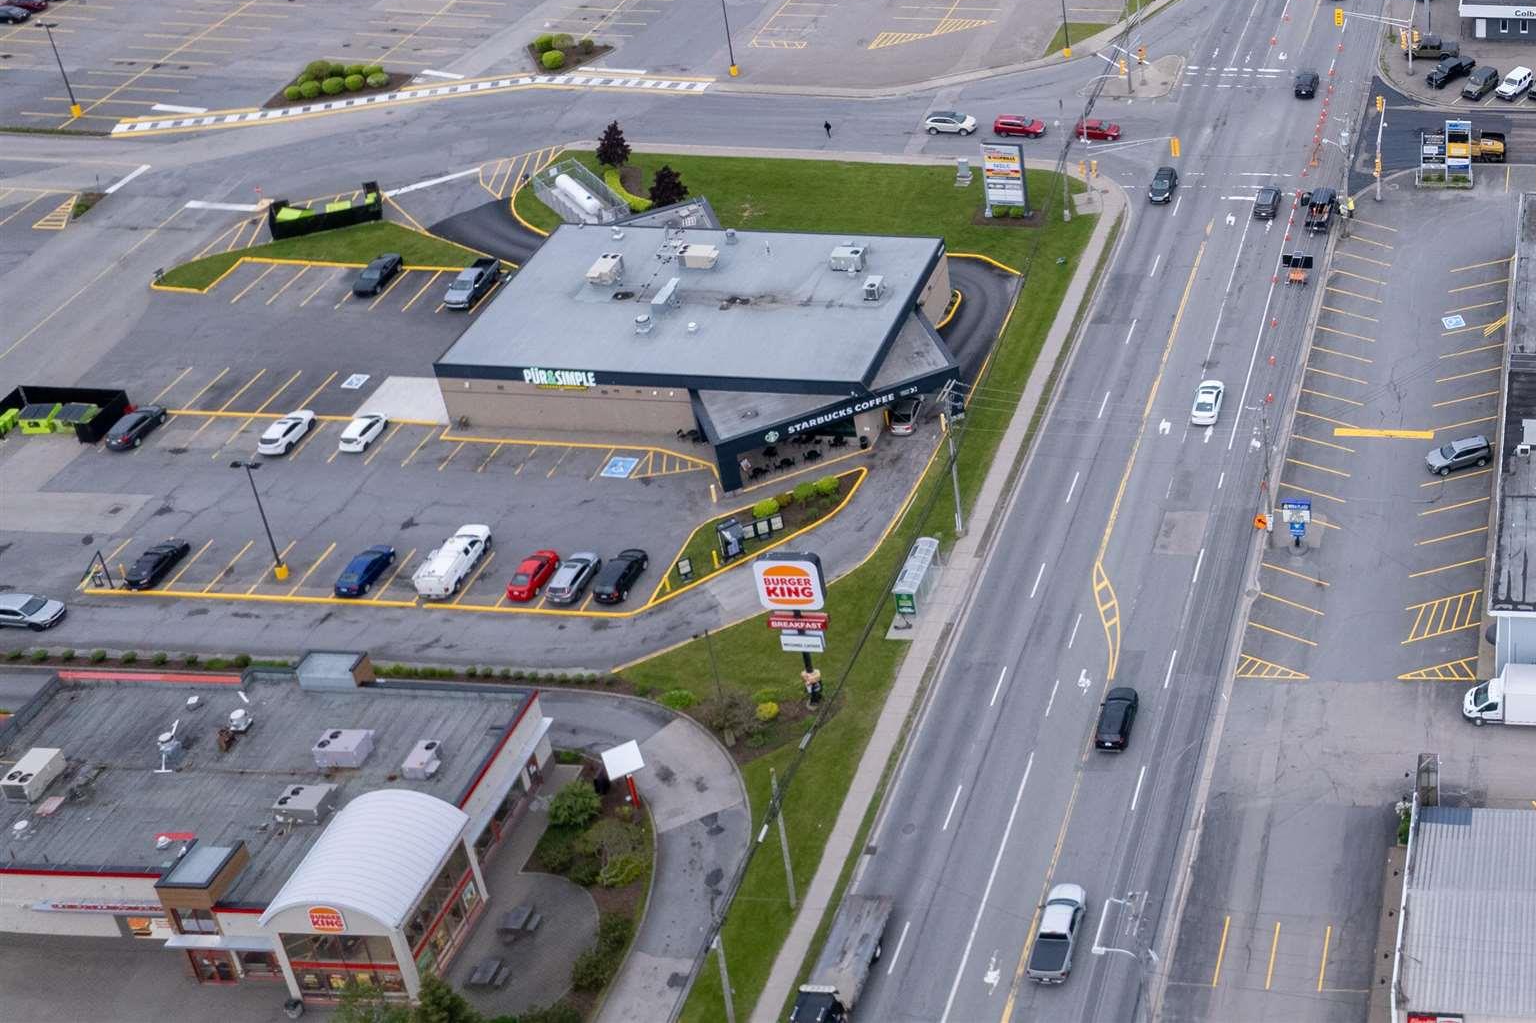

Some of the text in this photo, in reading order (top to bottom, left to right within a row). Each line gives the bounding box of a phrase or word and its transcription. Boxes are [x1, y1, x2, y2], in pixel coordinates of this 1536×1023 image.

[787, 393, 895, 434] STARBUCKS COFFEE
[763, 577, 812, 587] BURGER
[766, 587, 814, 598] KING
[771, 620, 822, 630] BREAKFAST
[312, 919, 344, 927] KING
